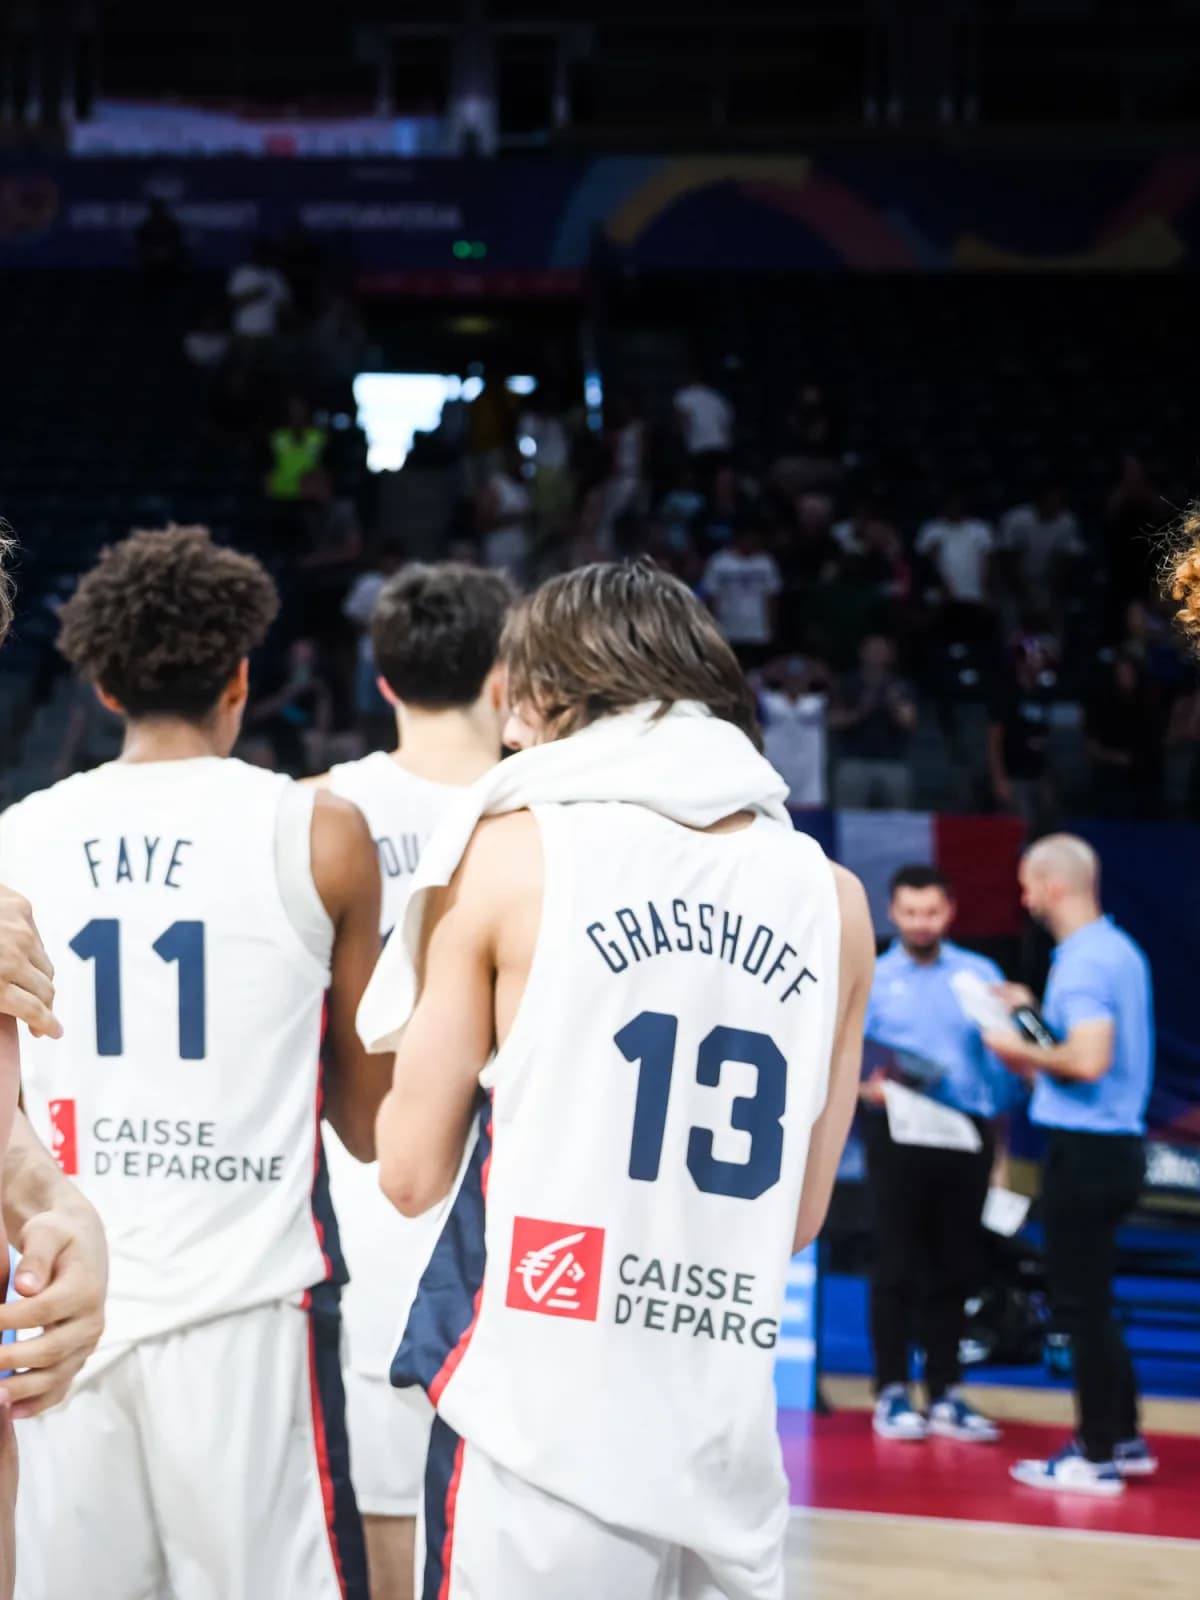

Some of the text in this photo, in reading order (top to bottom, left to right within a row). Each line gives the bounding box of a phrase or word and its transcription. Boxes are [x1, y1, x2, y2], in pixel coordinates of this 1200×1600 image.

[84, 836, 193, 888] FAYE
[586, 898, 818, 1003] GRASSHOFF
[68, 918, 206, 1060] 11
[613, 1010, 788, 1200] 13
[93, 1117, 216, 1148] CAISSE
[94, 1151, 285, 1182] D'EPARGNE
[619, 1253, 756, 1306] CAISSE
